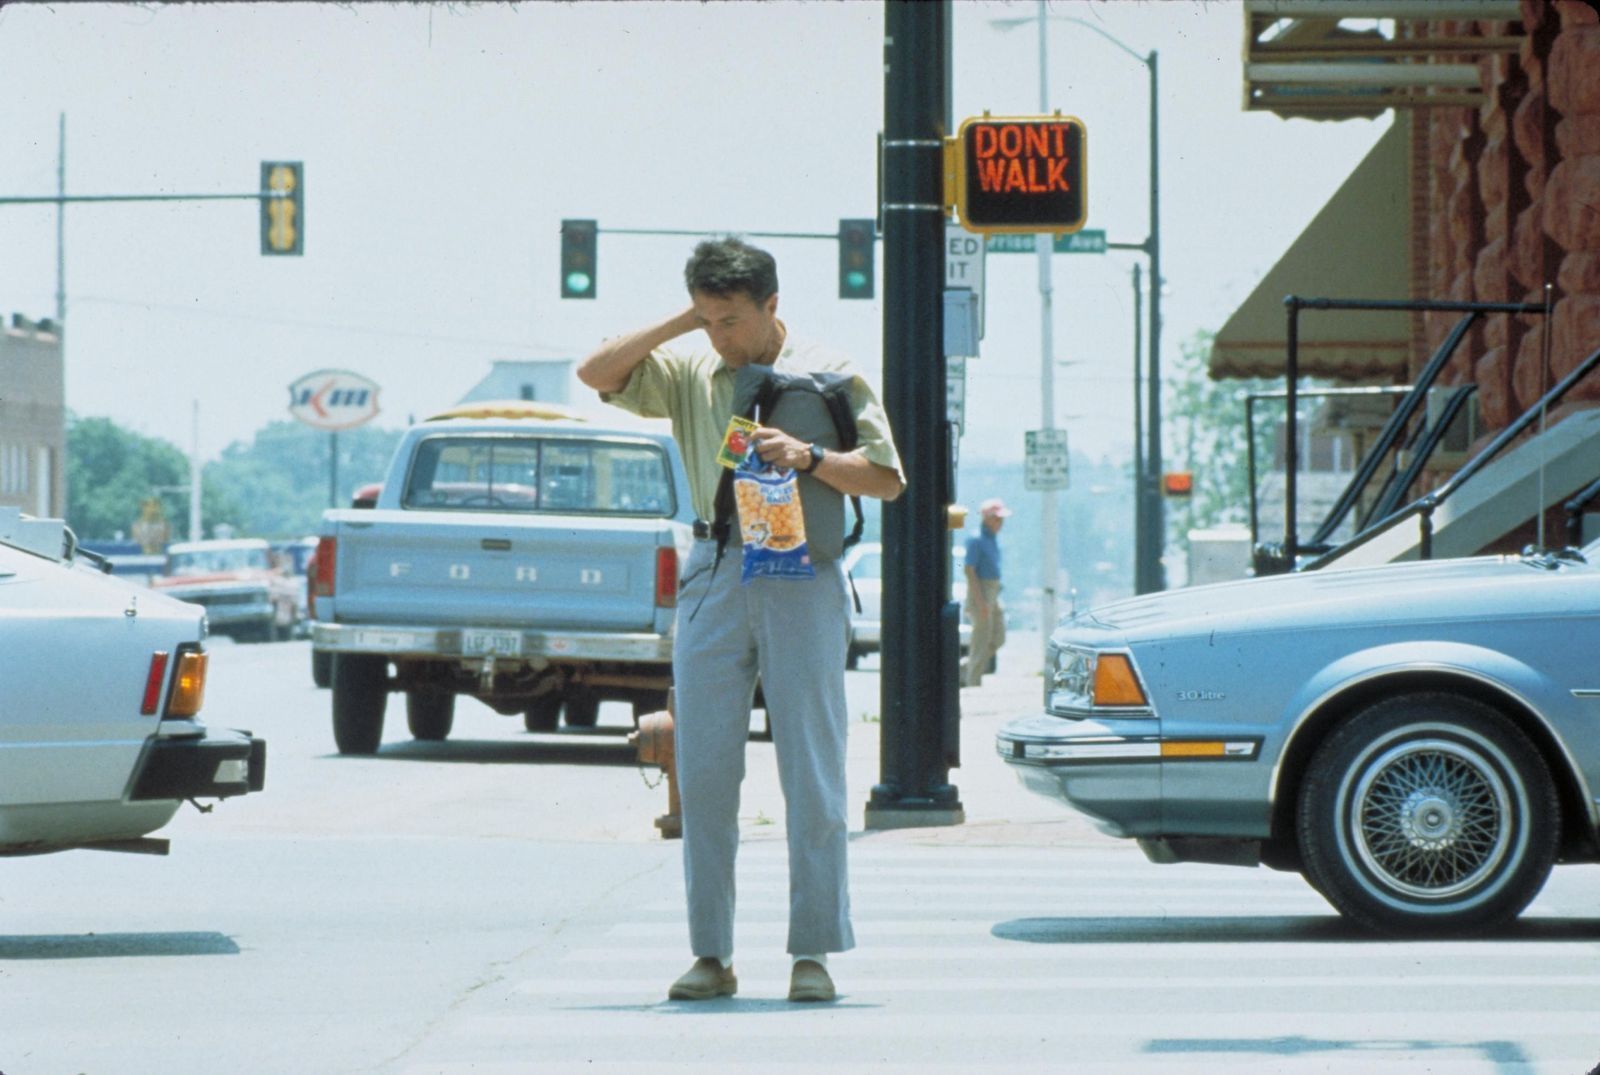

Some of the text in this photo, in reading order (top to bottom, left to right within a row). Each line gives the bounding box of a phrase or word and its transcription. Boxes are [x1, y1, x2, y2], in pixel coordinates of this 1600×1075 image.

[975, 125, 1069, 158] DONT
[977, 158, 1069, 192] WALK
[390, 562, 602, 584] FORD
